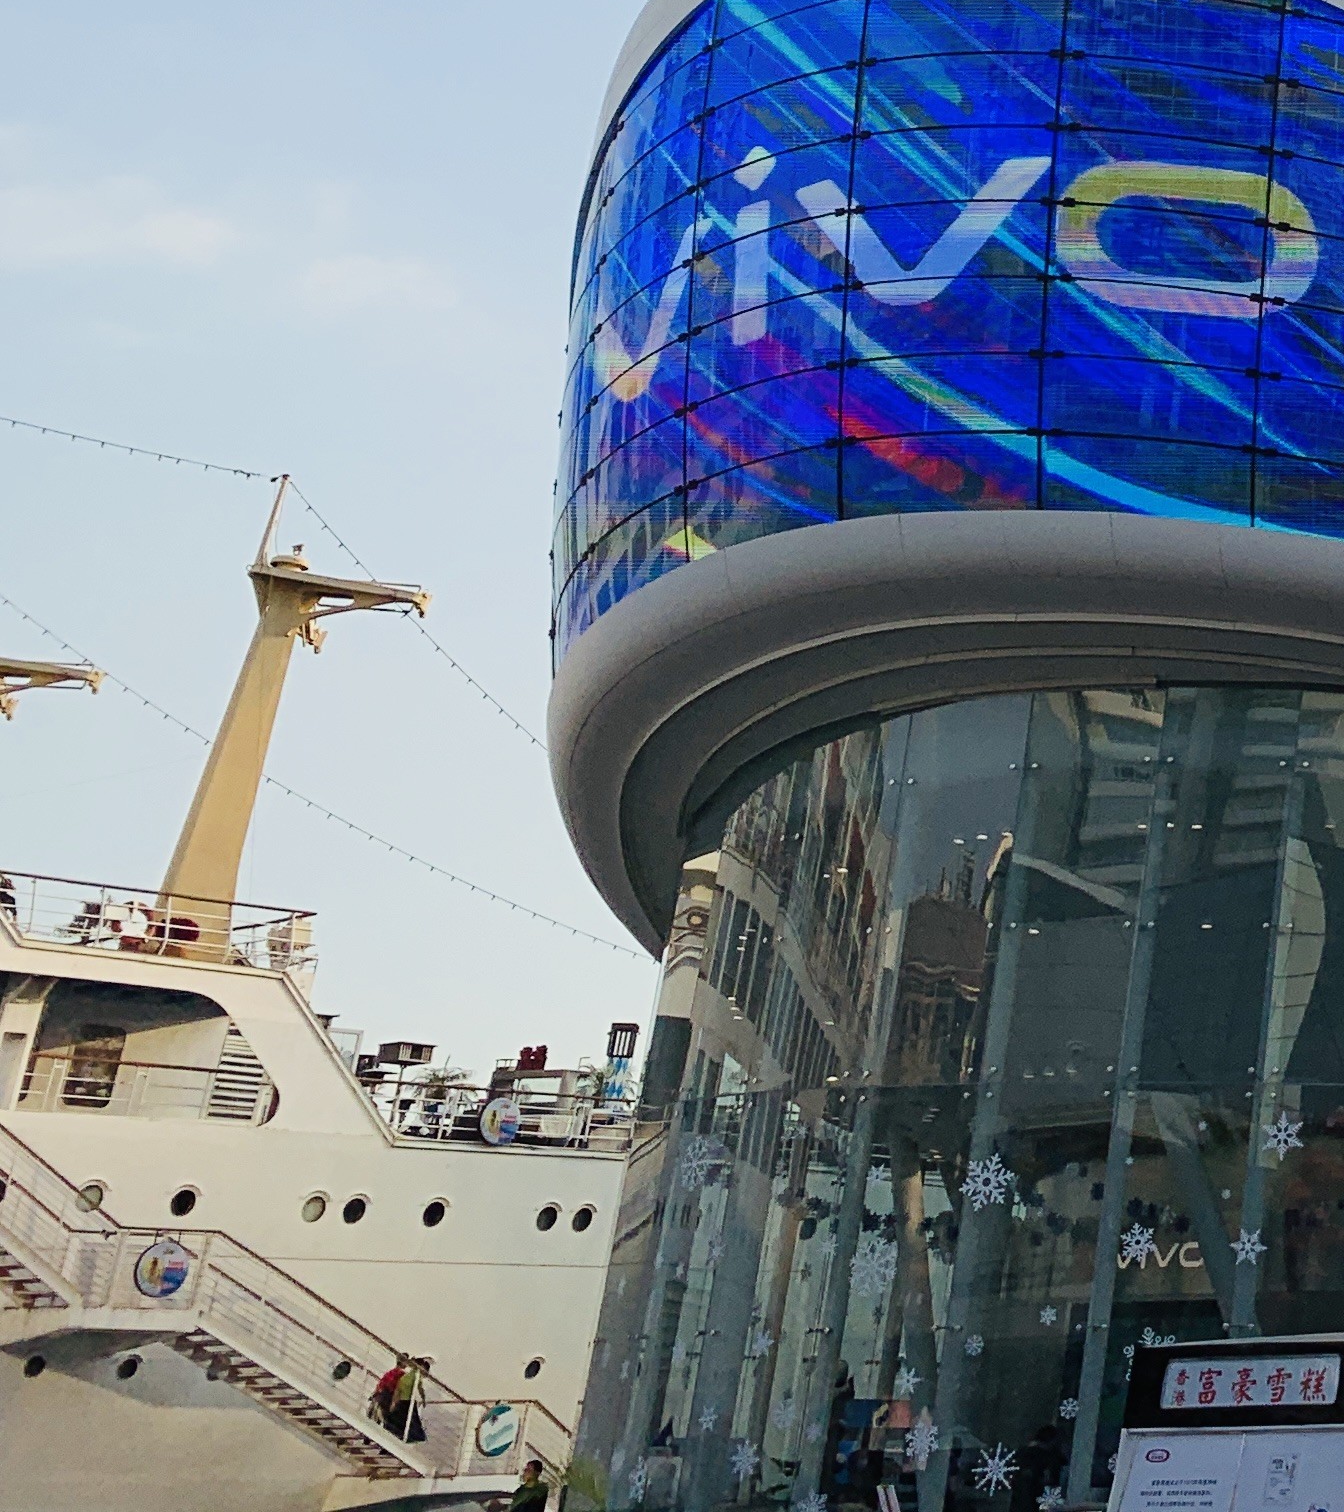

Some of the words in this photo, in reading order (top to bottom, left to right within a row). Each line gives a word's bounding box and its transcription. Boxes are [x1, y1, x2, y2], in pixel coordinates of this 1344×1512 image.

[594, 145, 1320, 402] vivo
[1197, 1367, 1328, 1404] 富豪雪糕
